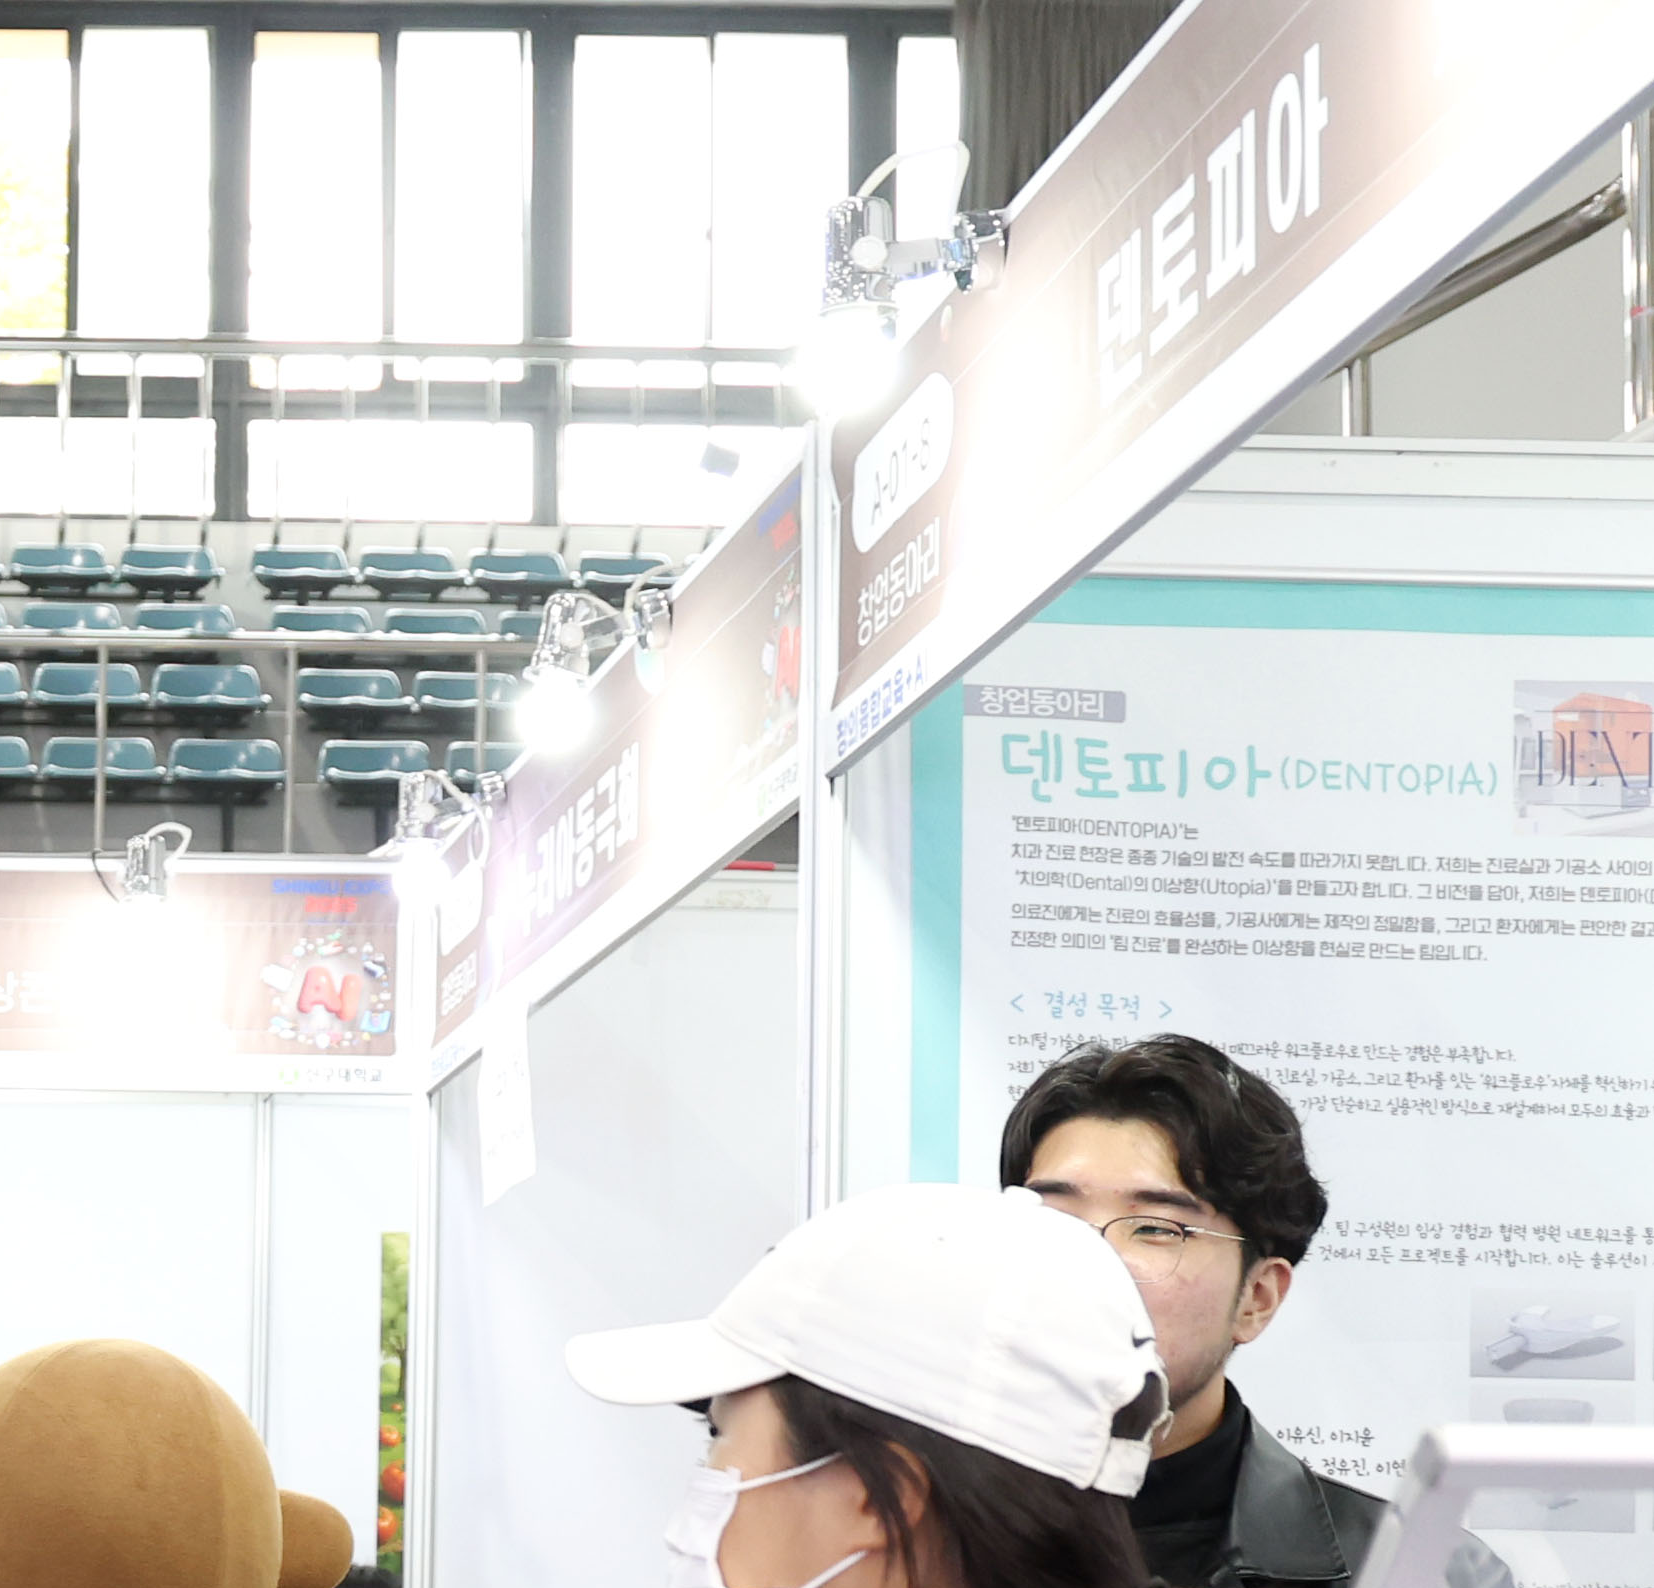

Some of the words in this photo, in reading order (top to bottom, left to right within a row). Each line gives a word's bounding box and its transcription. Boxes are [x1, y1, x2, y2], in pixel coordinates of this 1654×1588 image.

[1094, 43, 1328, 391] 덴토피아
[871, 417, 931, 526] A-01-8
[857, 516, 942, 648] 창업동아리
[980, 686, 1105, 719] 창업동아리
[1001, 730, 1498, 803] 덴토피아(DENTOPIA)
[1011, 842, 1042, 859] 치과
[1045, 843, 1076, 861] 진료
[1079, 845, 1124, 864] 현장은
[1127, 848, 1157, 866] 종종
[1161, 849, 1209, 867] 기술의
[1212, 850, 1244, 868] 발전
[1248, 851, 1295, 869] 속도를
[1299, 852, 1362, 870] 따라가지
[1366, 854, 1432, 873] 못합니다.
[1435, 856, 1483, 874] 저희는
[1486, 857, 1551, 875] 진료실과
[1554, 858, 1604, 875] 기공소
[1606, 859, 1653, 877] 사이의
[1296, 880, 1358, 897] 만들고자
[1362, 881, 1413, 899] 합니다.
[1416, 882, 1433, 899] 그
[1436, 883, 1484, 900] 비전을
[1528, 885, 1576, 903] 저희는
[1011, 902, 1102, 923] 의료진에게는
[1105, 906, 1150, 925] 진료의
[1154, 909, 1221, 929] 효율성을,
[1225, 911, 1320, 930] 기공사에게는
[1324, 913, 1370, 931] 제작의
[1373, 914, 1441, 934] 정밀함을,
[1444, 916, 1492, 934] 그리고
[1495, 917, 1576, 935] 환자에게는
[1580, 919, 1626, 937] 편안한
[1011, 930, 1057, 948] 진정한
[1060, 932, 1106, 951] 의미의
[1184, 937, 1249, 956] 완성하는
[1252, 939, 1315, 958] 이상향을
[1319, 941, 1365, 959] 현실로
[1369, 943, 1416, 960] 만드는
[1419, 944, 1488, 962] 팀입니다.
[297, 965, 364, 1023] AI
[1043, 990, 1087, 1019] 결성
[1097, 992, 1140, 1021] 목적
[1008, 1031, 1048, 1050] 디지털
[1284, 1041, 1362, 1060] 워크플로우로
[1364, 1043, 1403, 1062] 만드는
[1404, 1044, 1443, 1063] 경험은
[1445, 1046, 1516, 1064] 부족합니다.
[1364, 1071, 1403, 1087] 그리고
[1405, 1070, 1447, 1089] 환자를
[1595, 1074, 1648, 1092] 혁신하기
[1299, 1095, 1328, 1112] 가장
[1331, 1096, 1384, 1114] 단순하고
[1386, 1097, 1438, 1116] 실용적인
[1441, 1098, 1495, 1116] 방식으로
[1568, 1102, 1608, 1117] 모두의
[1335, 1220, 1350, 1237] 팀
[1354, 1221, 1411, 1240] 구성원의
[1415, 1222, 1444, 1240] 임상
[1449, 1223, 1493, 1241] 경험과
[1499, 1223, 1528, 1243] 협력
[1532, 1224, 1561, 1244] 병원
[1566, 1225, 1638, 1245] 네트워크를
[1318, 1244, 1362, 1262] 것에서
[1365, 1245, 1395, 1265] 모든
[1398, 1247, 1470, 1267] 프로젝트를
[1474, 1248, 1552, 1268] 시작합니다.
[1557, 1250, 1586, 1269] 이는
[1589, 1251, 1648, 1270] 솔루션이
